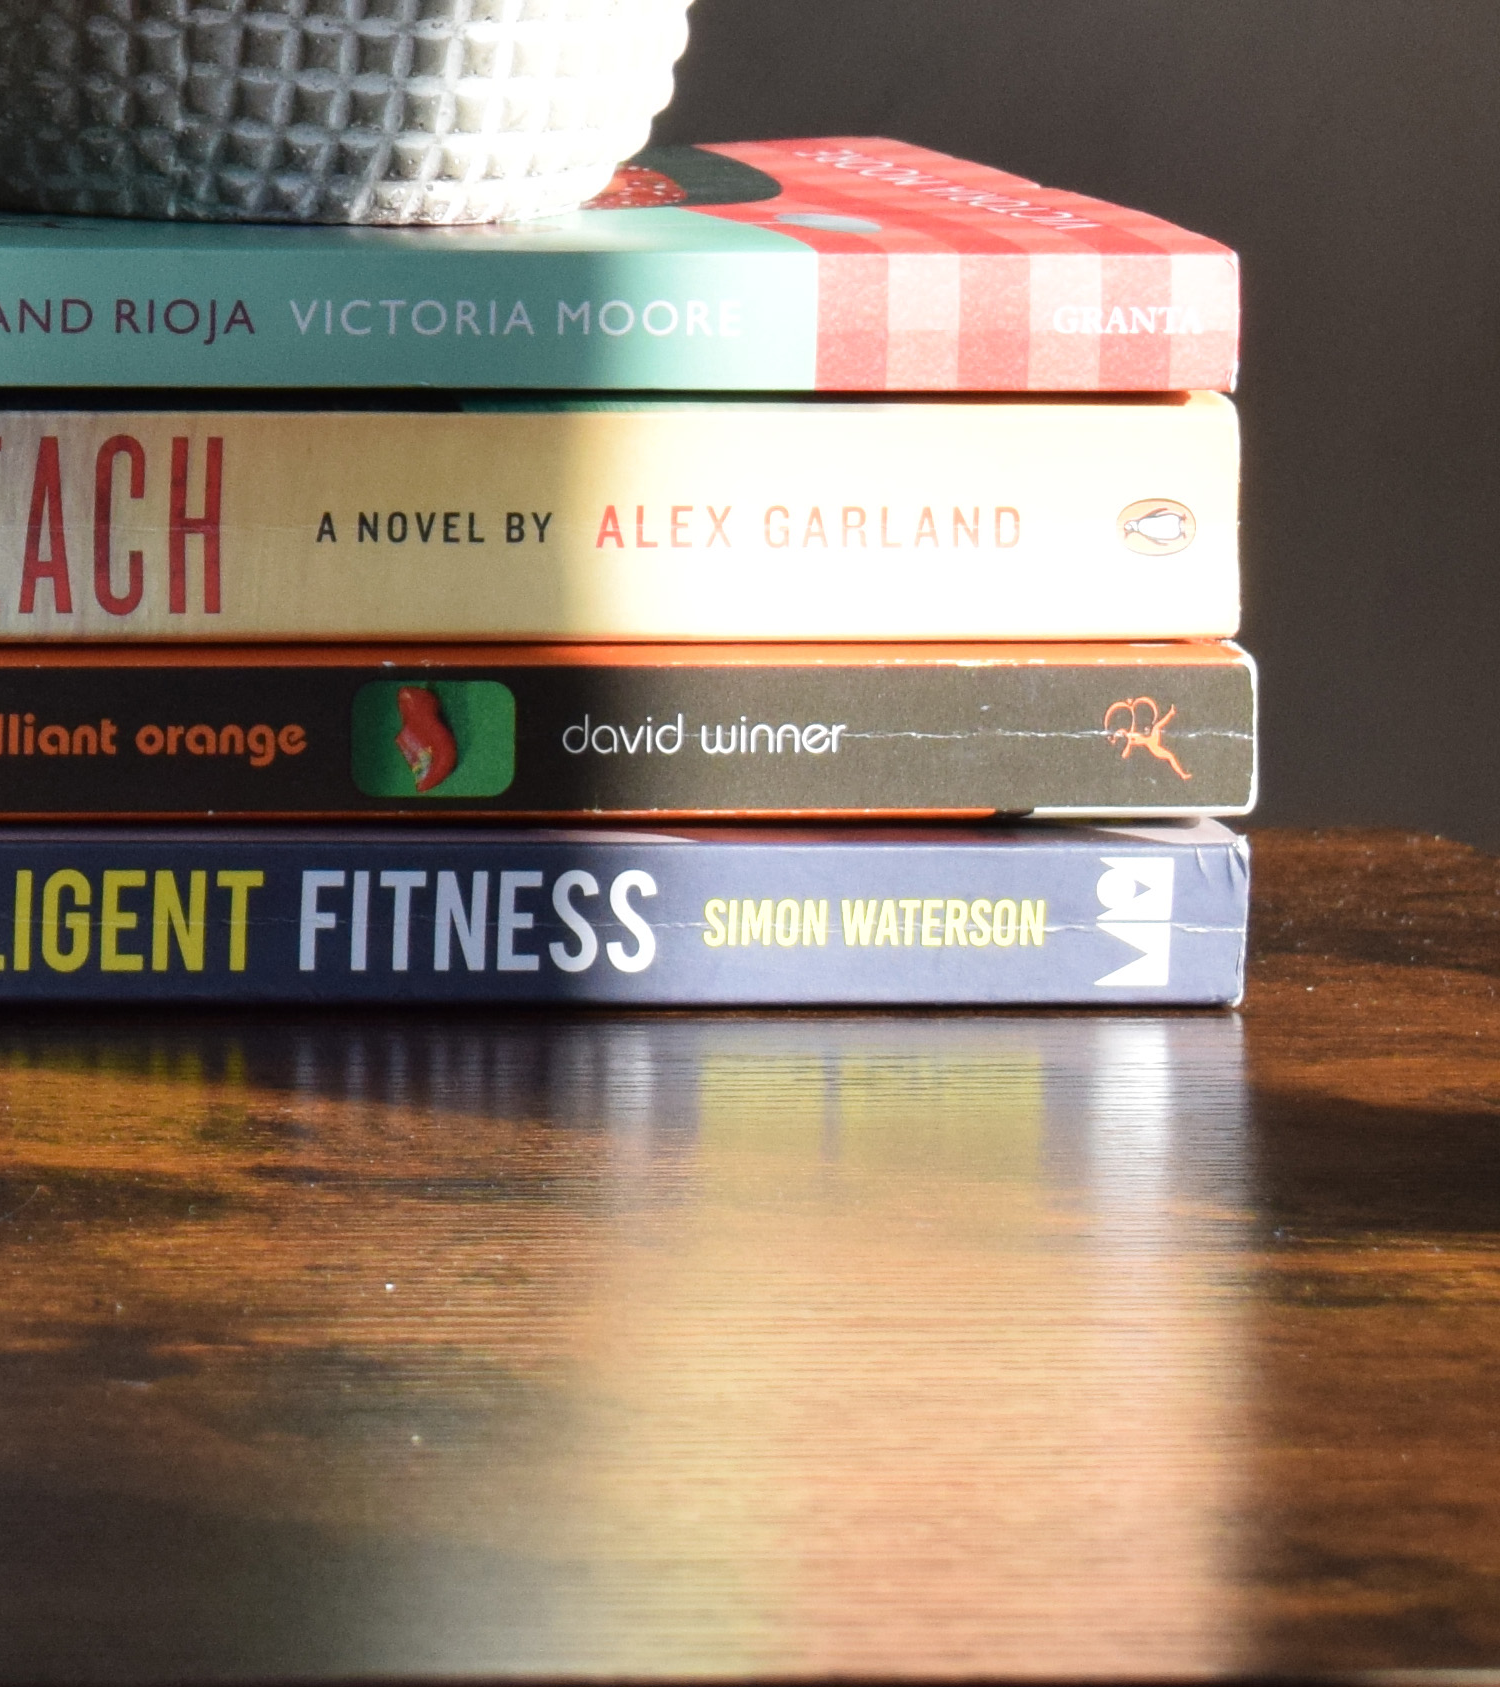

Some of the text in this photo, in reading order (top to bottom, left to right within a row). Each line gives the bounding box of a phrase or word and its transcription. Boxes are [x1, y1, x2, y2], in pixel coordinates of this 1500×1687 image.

[114, 298, 256, 345] RIOJA
[289, 299, 743, 337] VICTORIA MOORE
[1052, 305, 1204, 335] GRANTA
[315, 511, 553, 544] A NOVEL BY
[594, 504, 1022, 549] ALEX GARLAND
[134, 723, 308, 768] orange
[561, 712, 848, 754] david winner
[298, 868, 660, 974] FITNESS
[702, 897, 1047, 948] SIMON WATERSON
